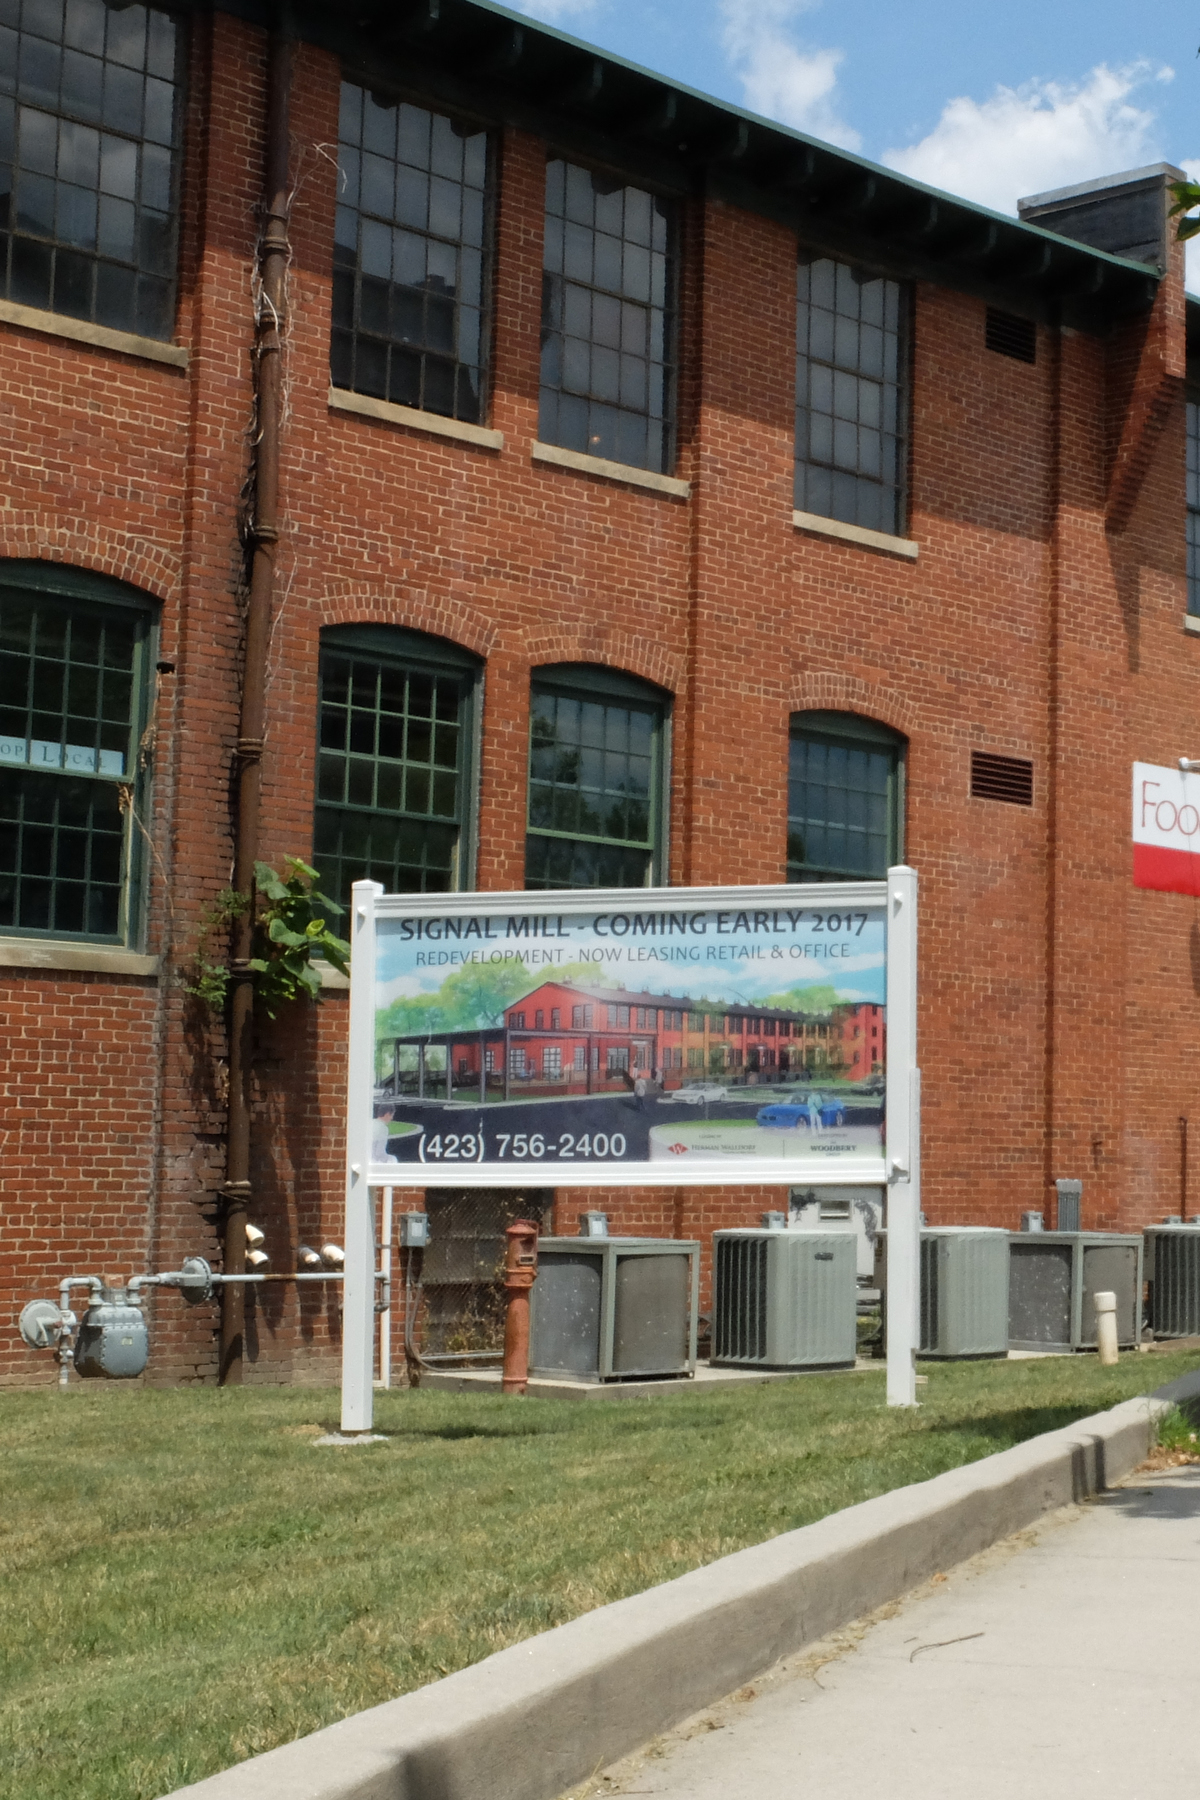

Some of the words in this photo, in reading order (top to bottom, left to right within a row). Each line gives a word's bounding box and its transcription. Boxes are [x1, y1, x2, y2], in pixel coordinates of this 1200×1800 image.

[400, 917, 498, 941] SIGNAL
[505, 914, 570, 938] MILL
[592, 911, 707, 937] COMING
[716, 910, 804, 934] EARLY
[811, 912, 869, 937] 2017
[416, 948, 564, 967] REDEVELOPMENT
[578, 947, 623, 963] NOW
[627, 946, 700, 962] LEASING
[706, 944, 766, 960] RETAIL
[770, 944, 784, 959] &
[789, 943, 850, 959] OFFICE
[418, 1133, 485, 1163] (423)
[495, 1132, 627, 1158] 756-2400
